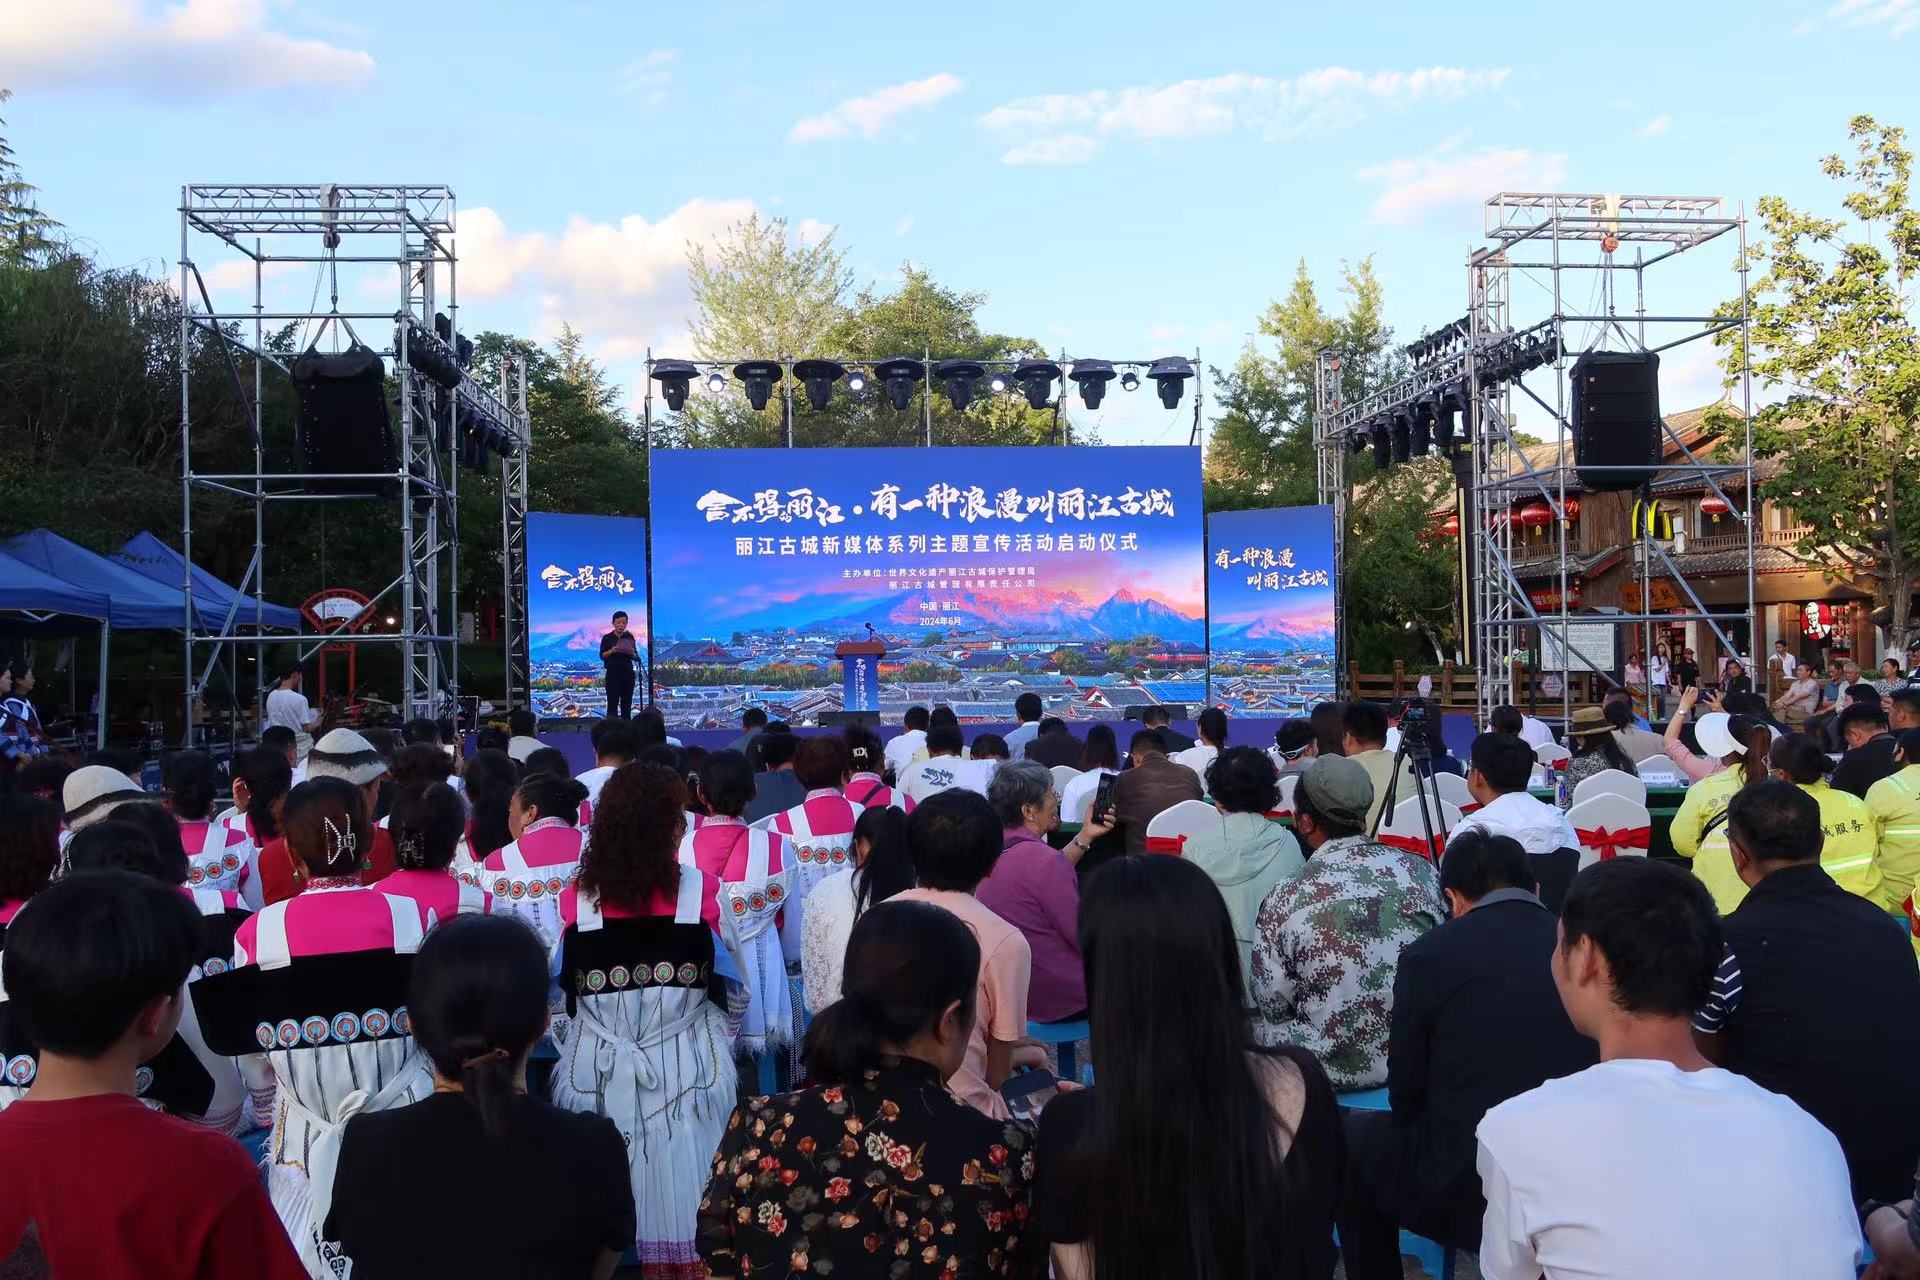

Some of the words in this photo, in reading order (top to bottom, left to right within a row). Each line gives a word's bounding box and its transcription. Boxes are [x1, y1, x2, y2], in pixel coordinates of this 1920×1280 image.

[735, 531, 1138, 556] 丽江古城新媒体系列主题宣传活动启动仪式
[1214, 547, 1296, 570] 有一种浪漫
[888, 579, 1036, 590] 丽江古城管理有限责任公司
[1246, 569, 1329, 592] 叫丽江古城
[919, 601, 960, 612] 中国·丽江
[919, 616, 962, 627] 2024年6月
